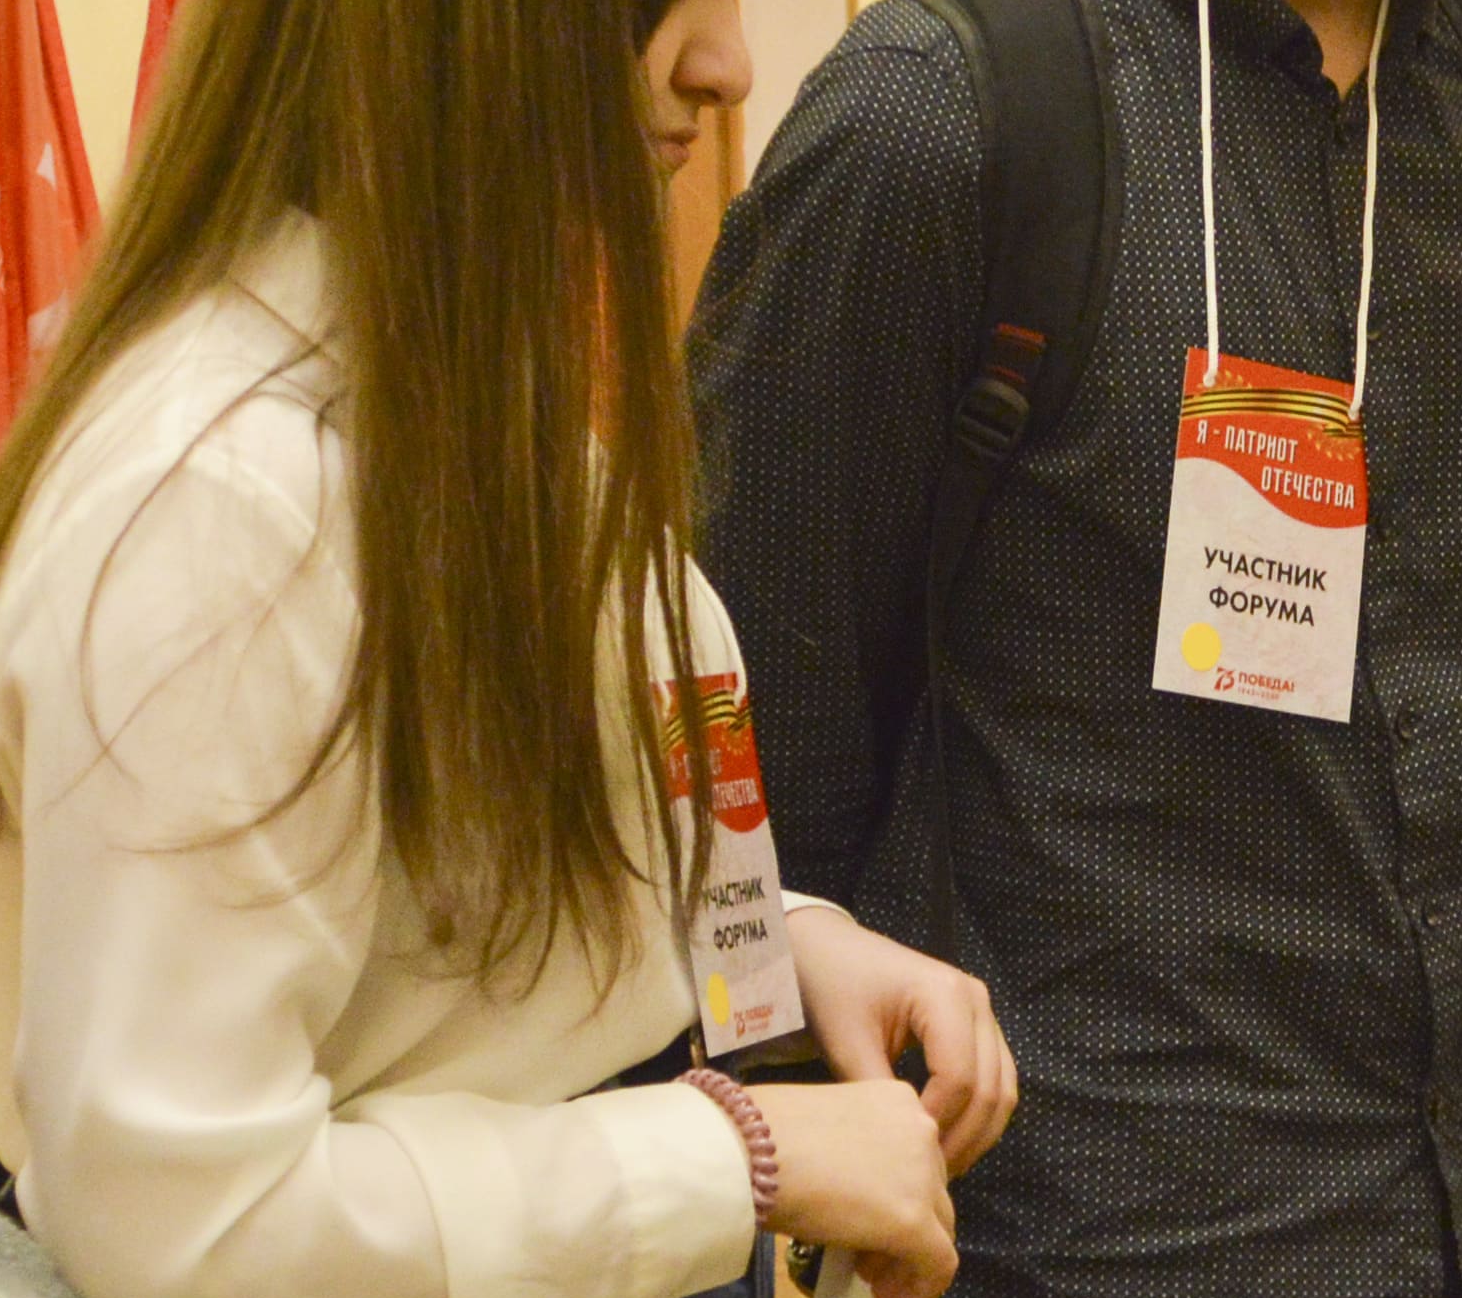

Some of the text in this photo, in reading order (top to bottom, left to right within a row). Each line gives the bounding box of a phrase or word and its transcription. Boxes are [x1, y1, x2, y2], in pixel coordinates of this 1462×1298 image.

[1196, 419, 1208, 445] Я
[1225, 425, 1298, 464] ПАТРИОТ
[1261, 465, 1355, 510] ОТЕЧЕСТВА
[1204, 546, 1327, 591] УЧАСТНИК
[1209, 585, 1315, 627] ФОРУМА
[1238, 671, 1295, 693] ПОБЕДА!
[713, 778, 758, 811] ТЕЧЕСТВА
[713, 917, 769, 951] ФОРУМА
